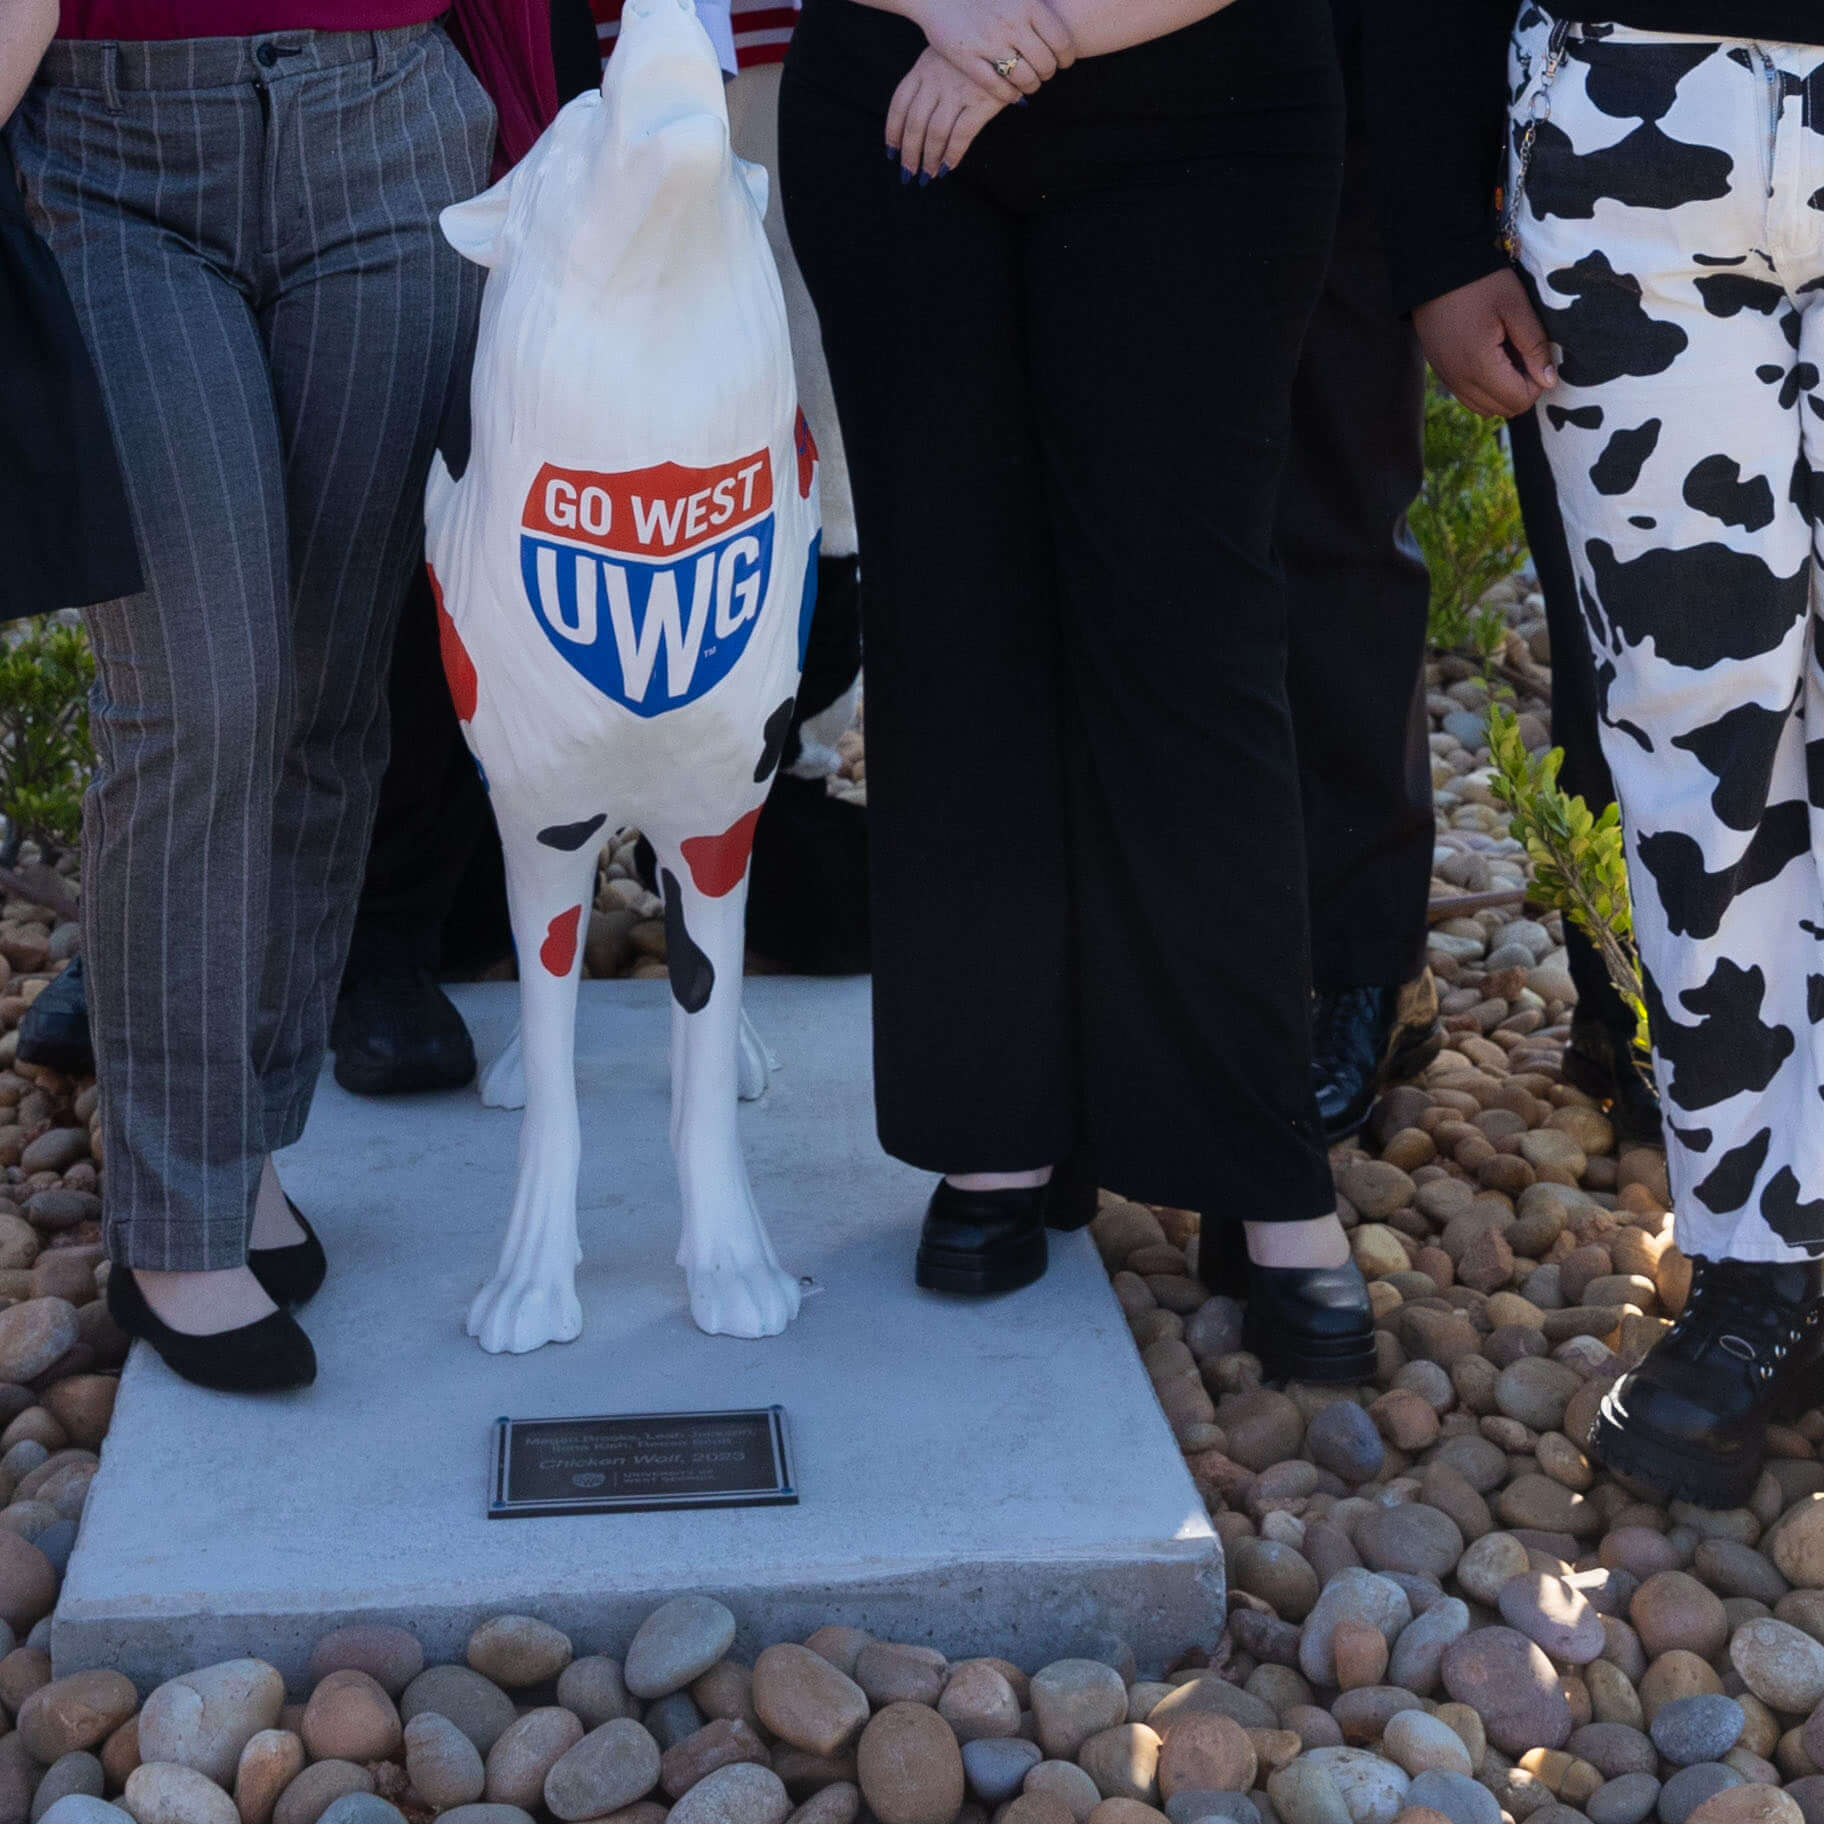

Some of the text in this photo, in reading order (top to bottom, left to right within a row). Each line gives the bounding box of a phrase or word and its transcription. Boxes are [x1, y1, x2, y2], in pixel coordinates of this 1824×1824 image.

[544, 460, 764, 547] GO WEST
[536, 535, 761, 704] UWG
